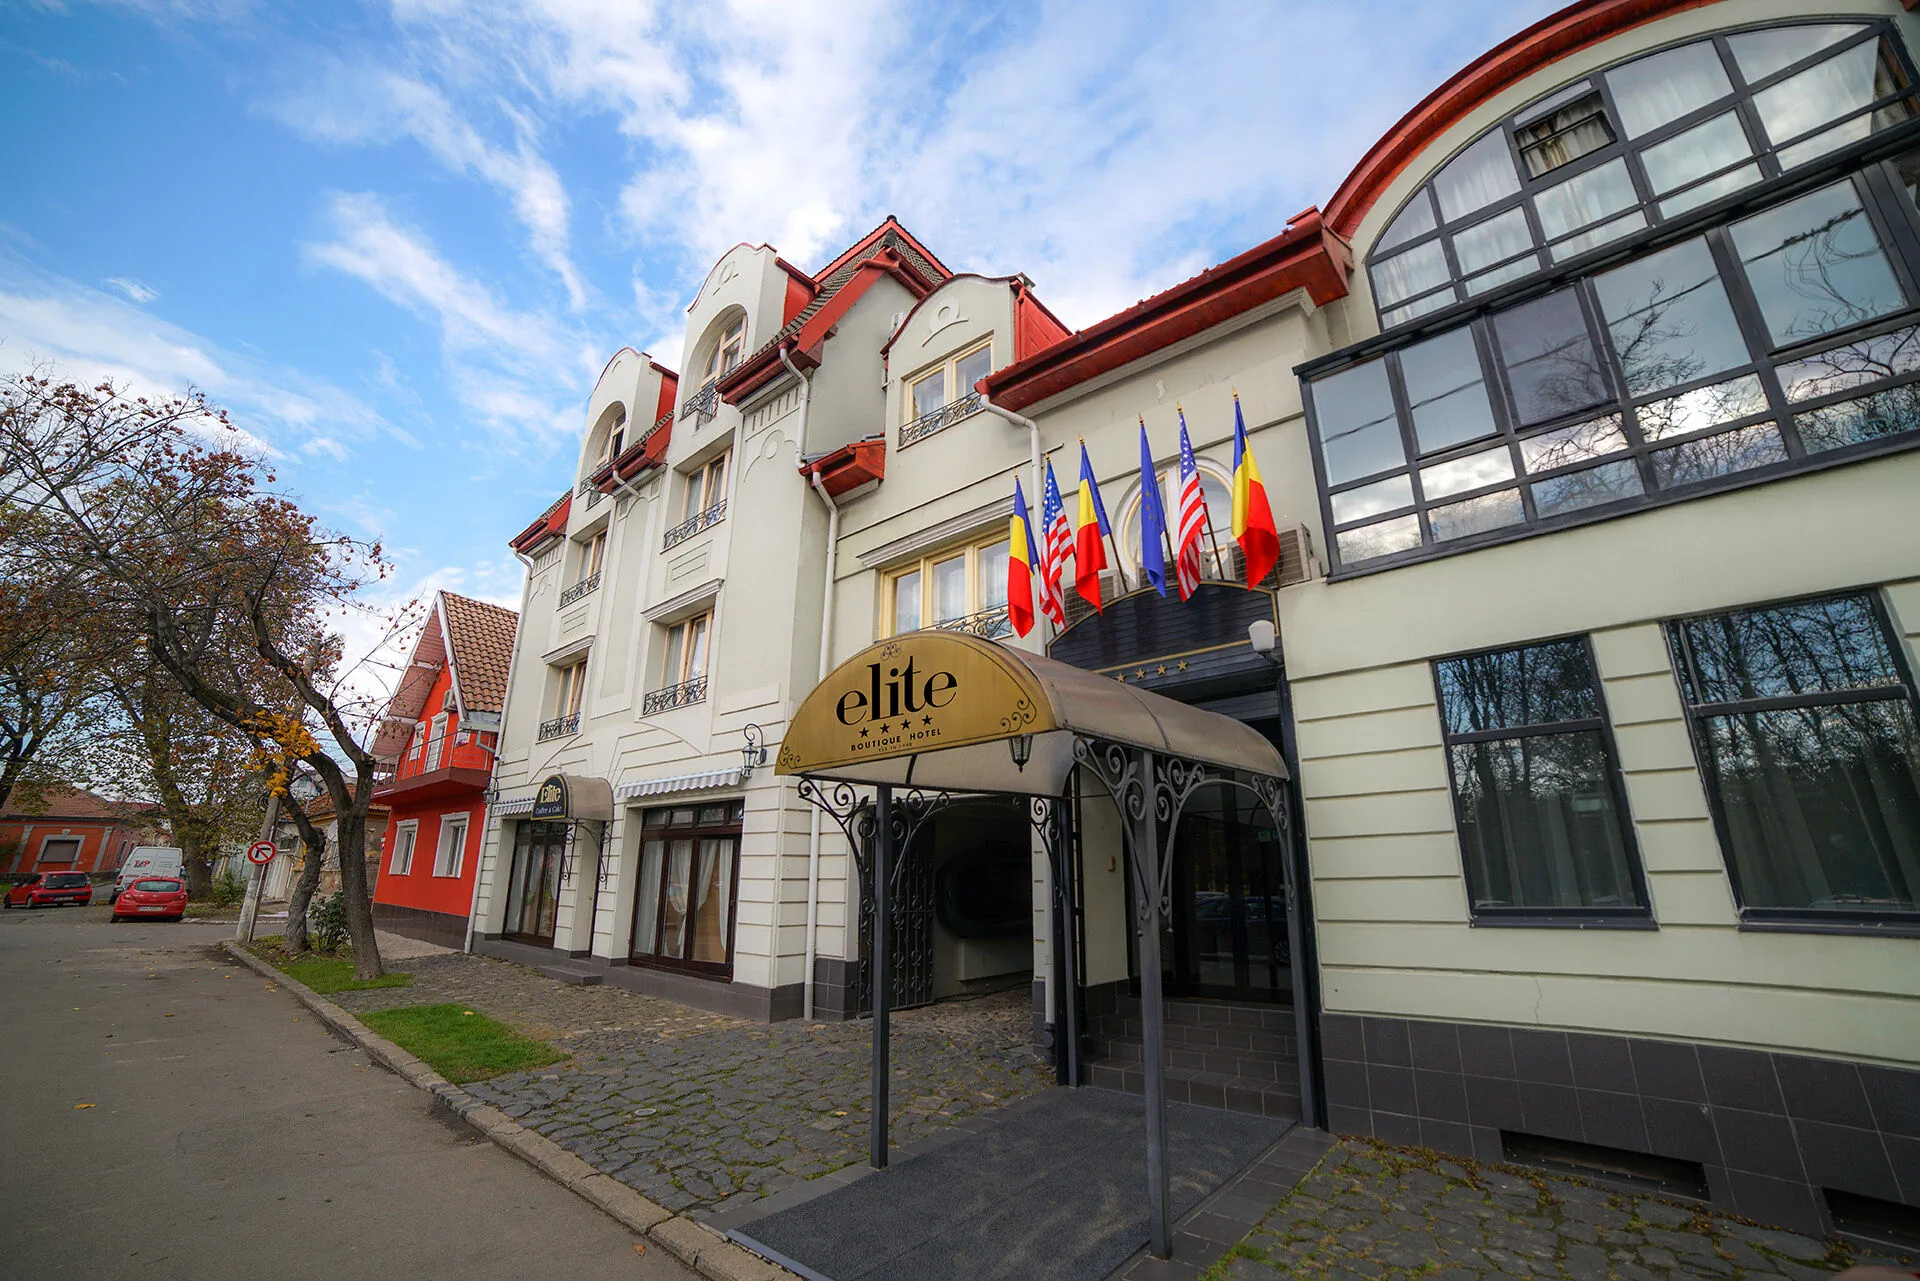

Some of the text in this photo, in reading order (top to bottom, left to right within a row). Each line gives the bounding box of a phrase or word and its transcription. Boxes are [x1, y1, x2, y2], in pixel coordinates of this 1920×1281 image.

[836, 655, 957, 726] elite
[851, 736, 901, 751] BOUTIQUE
[909, 728, 942, 741] HOTEL
